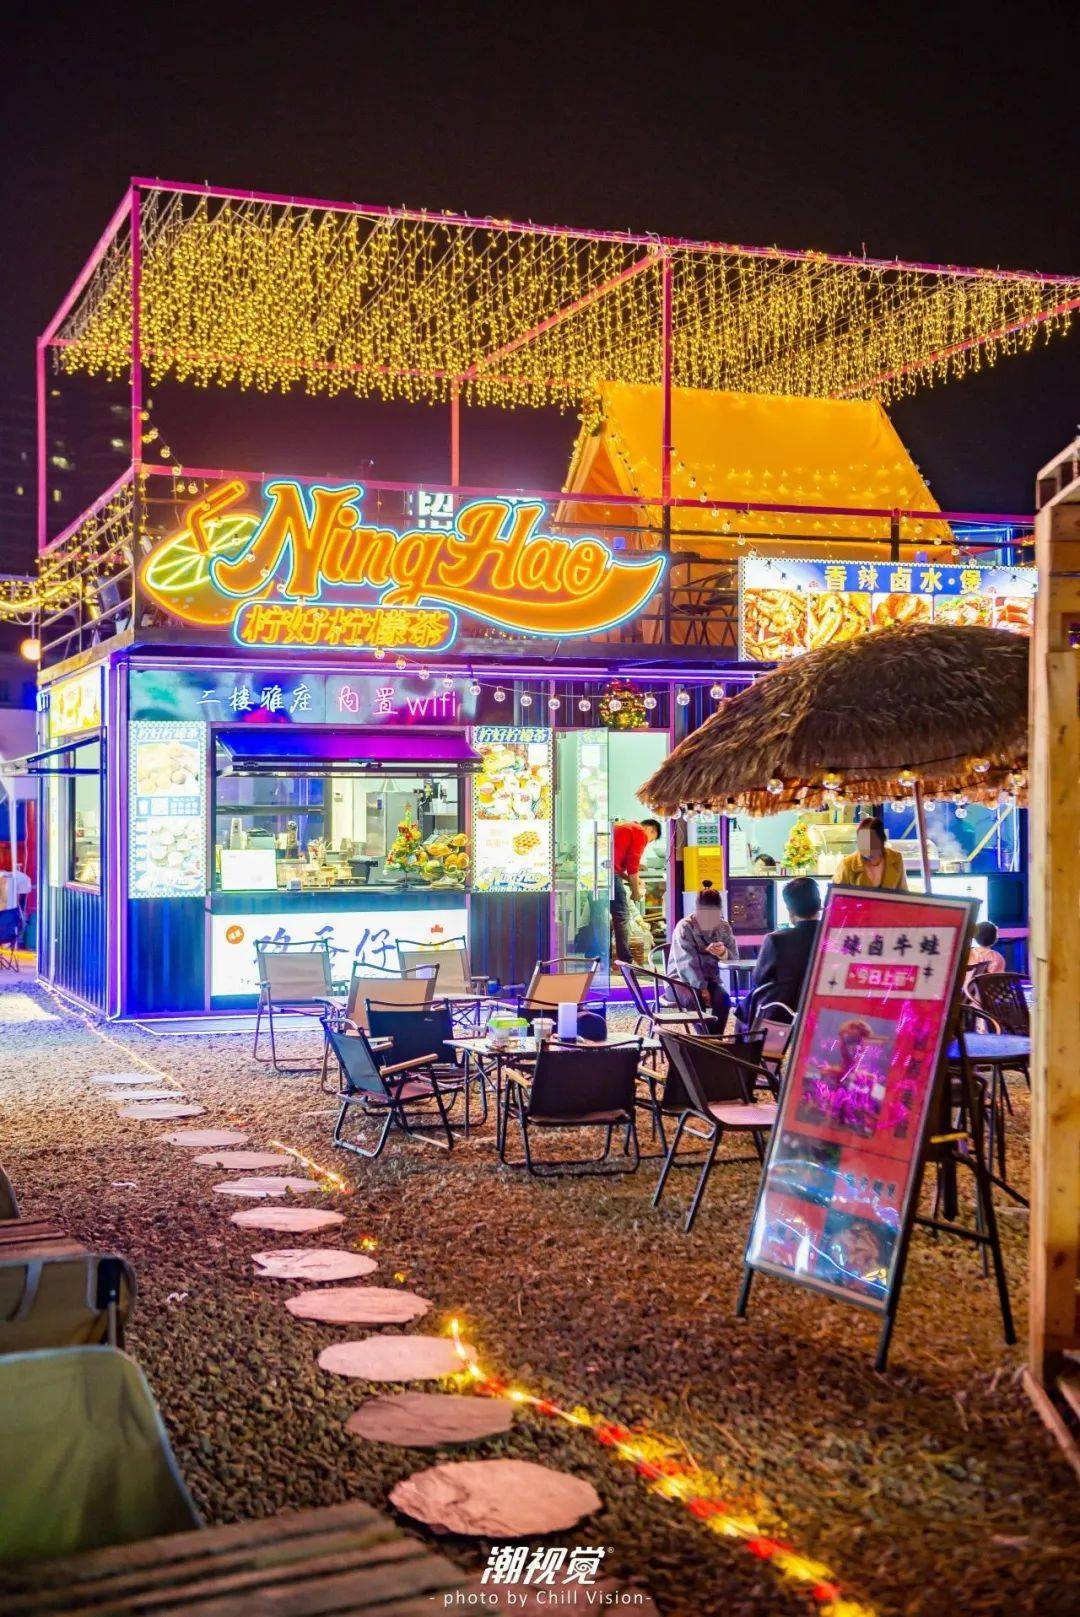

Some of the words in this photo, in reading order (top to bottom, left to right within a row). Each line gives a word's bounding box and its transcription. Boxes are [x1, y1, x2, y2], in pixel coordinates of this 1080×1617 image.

[242, 604, 450, 649] 柠好柠檬茶
[196, 684, 314, 714] 二楼雅座
